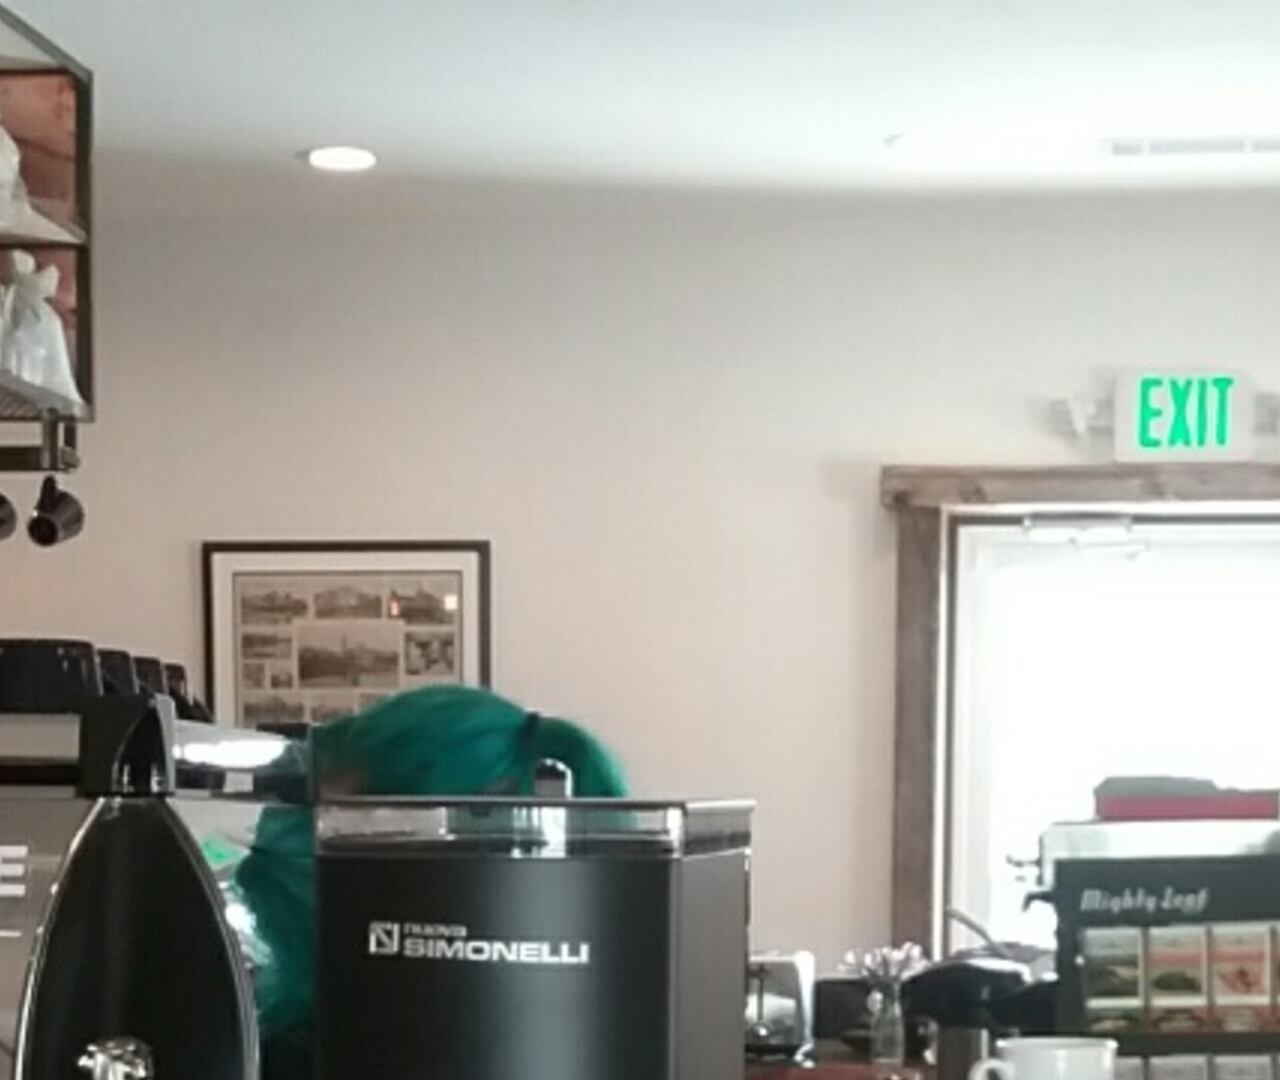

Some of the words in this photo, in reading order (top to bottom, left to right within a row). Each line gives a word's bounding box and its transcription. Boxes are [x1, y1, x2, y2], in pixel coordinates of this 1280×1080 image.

[1139, 376, 1235, 448] EXIT
[1080, 886, 1158, 914] Mighty
[402, 937, 590, 965] SIMONELLI
